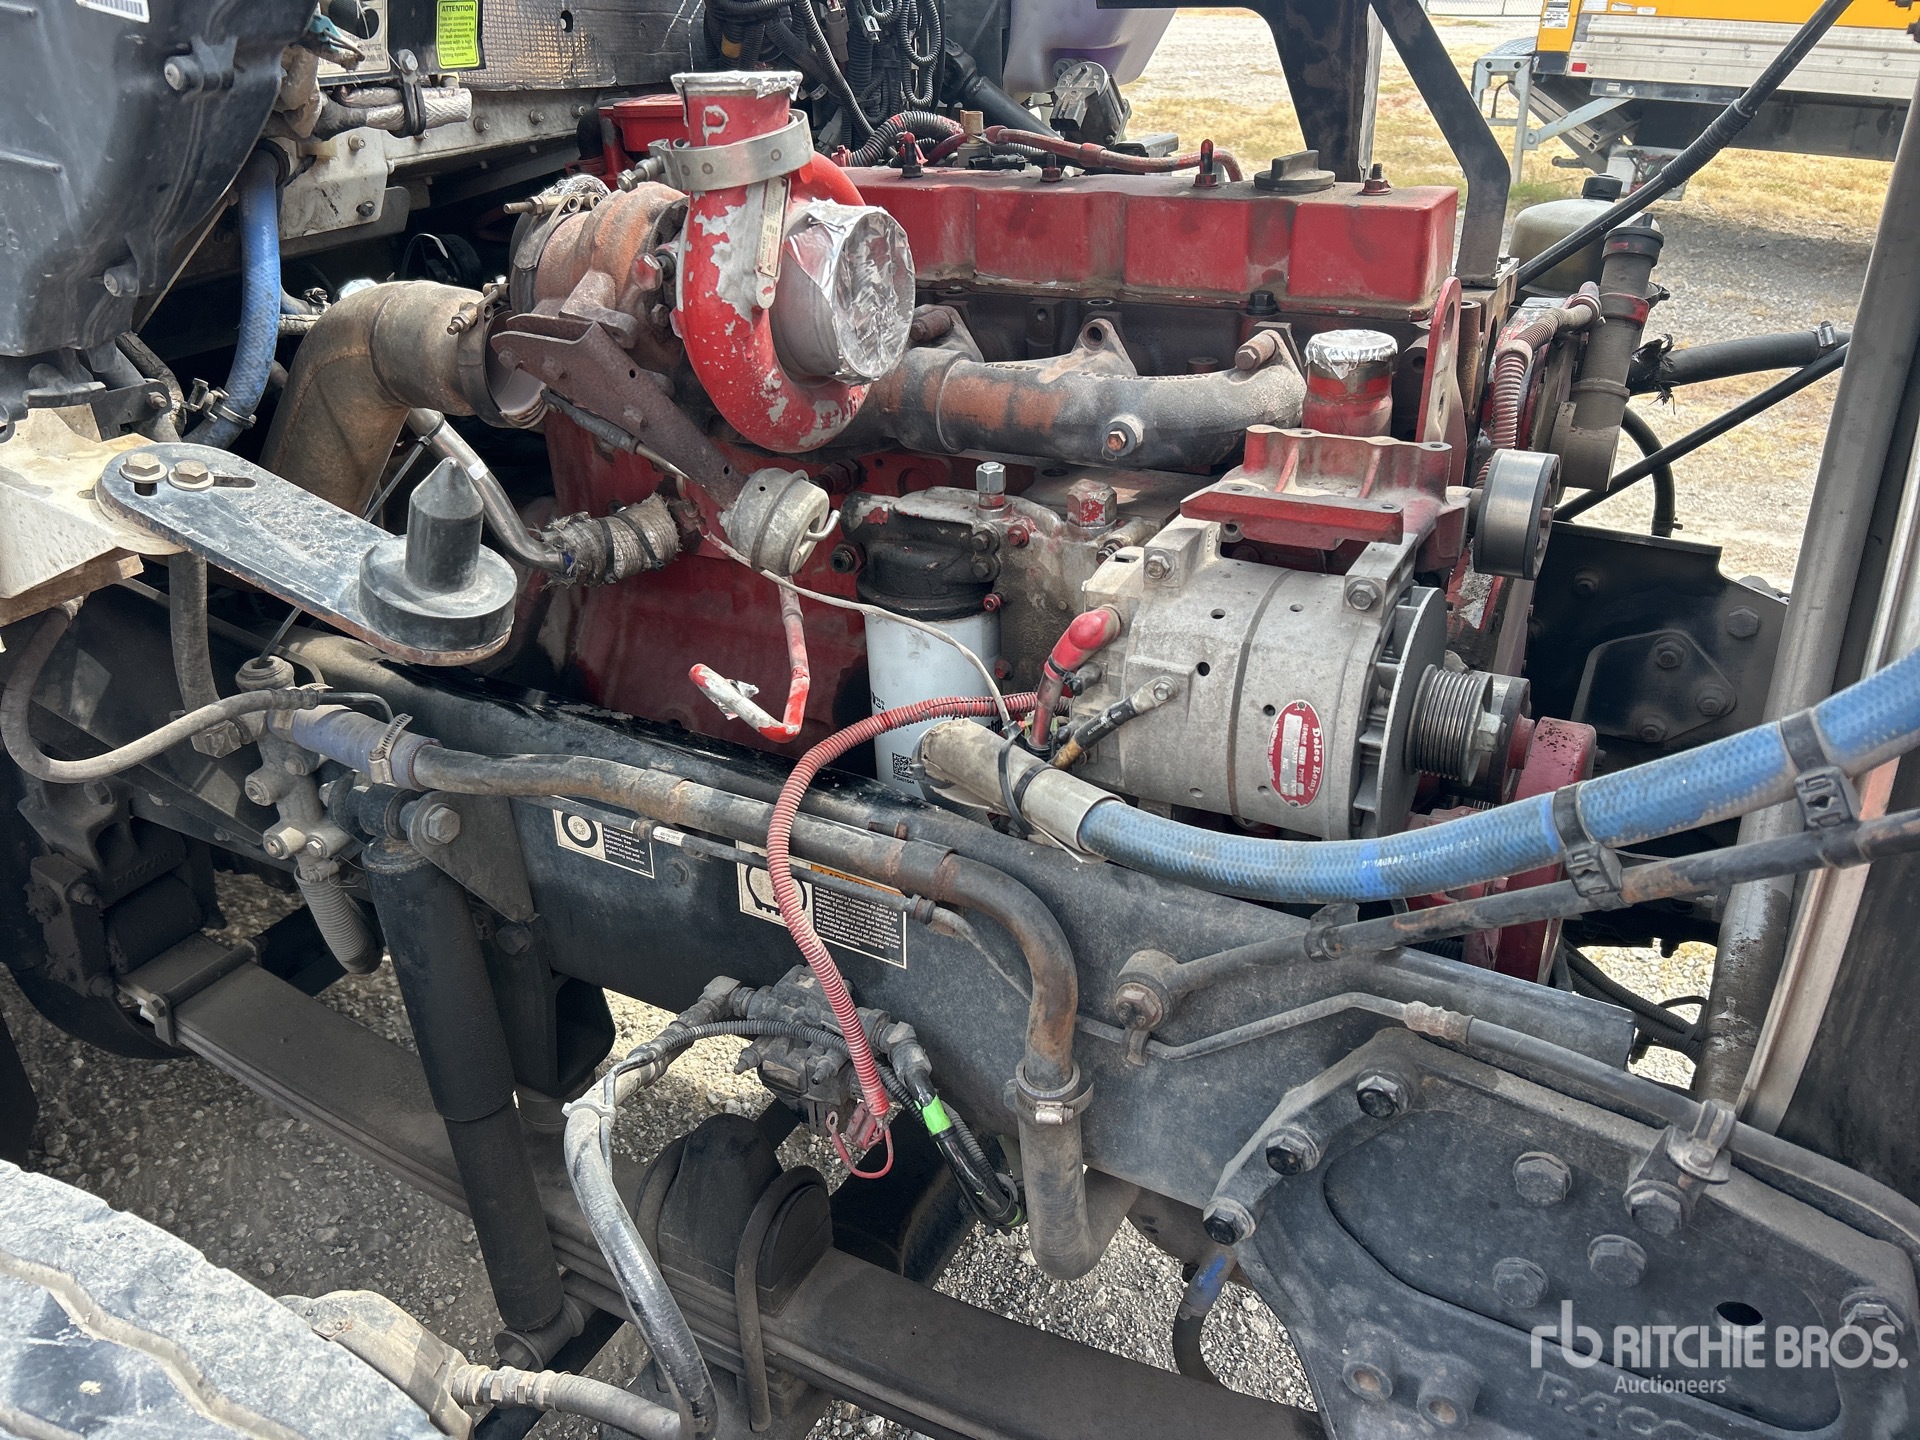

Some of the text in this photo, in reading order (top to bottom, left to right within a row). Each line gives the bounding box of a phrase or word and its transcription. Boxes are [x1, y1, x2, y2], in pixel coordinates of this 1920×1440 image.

[1308, 728, 1322, 794] Delco Remy
[604, 828, 620, 836] Maintain
[815, 892, 835, 901] instalado
[873, 911, 889, 919] original
[816, 902, 835, 912] diferente
[881, 924, 896, 932] válvula
[875, 917, 892, 926] tamaño
[817, 928, 835, 937] lesiones
[821, 925, 849, 937] consiguiente
[850, 935, 877, 947] probabilidad
[823, 920, 839, 929] pérdida
[870, 937, 889, 946] vehículo
[872, 927, 900, 939] componente
[884, 936, 901, 944] resultar
